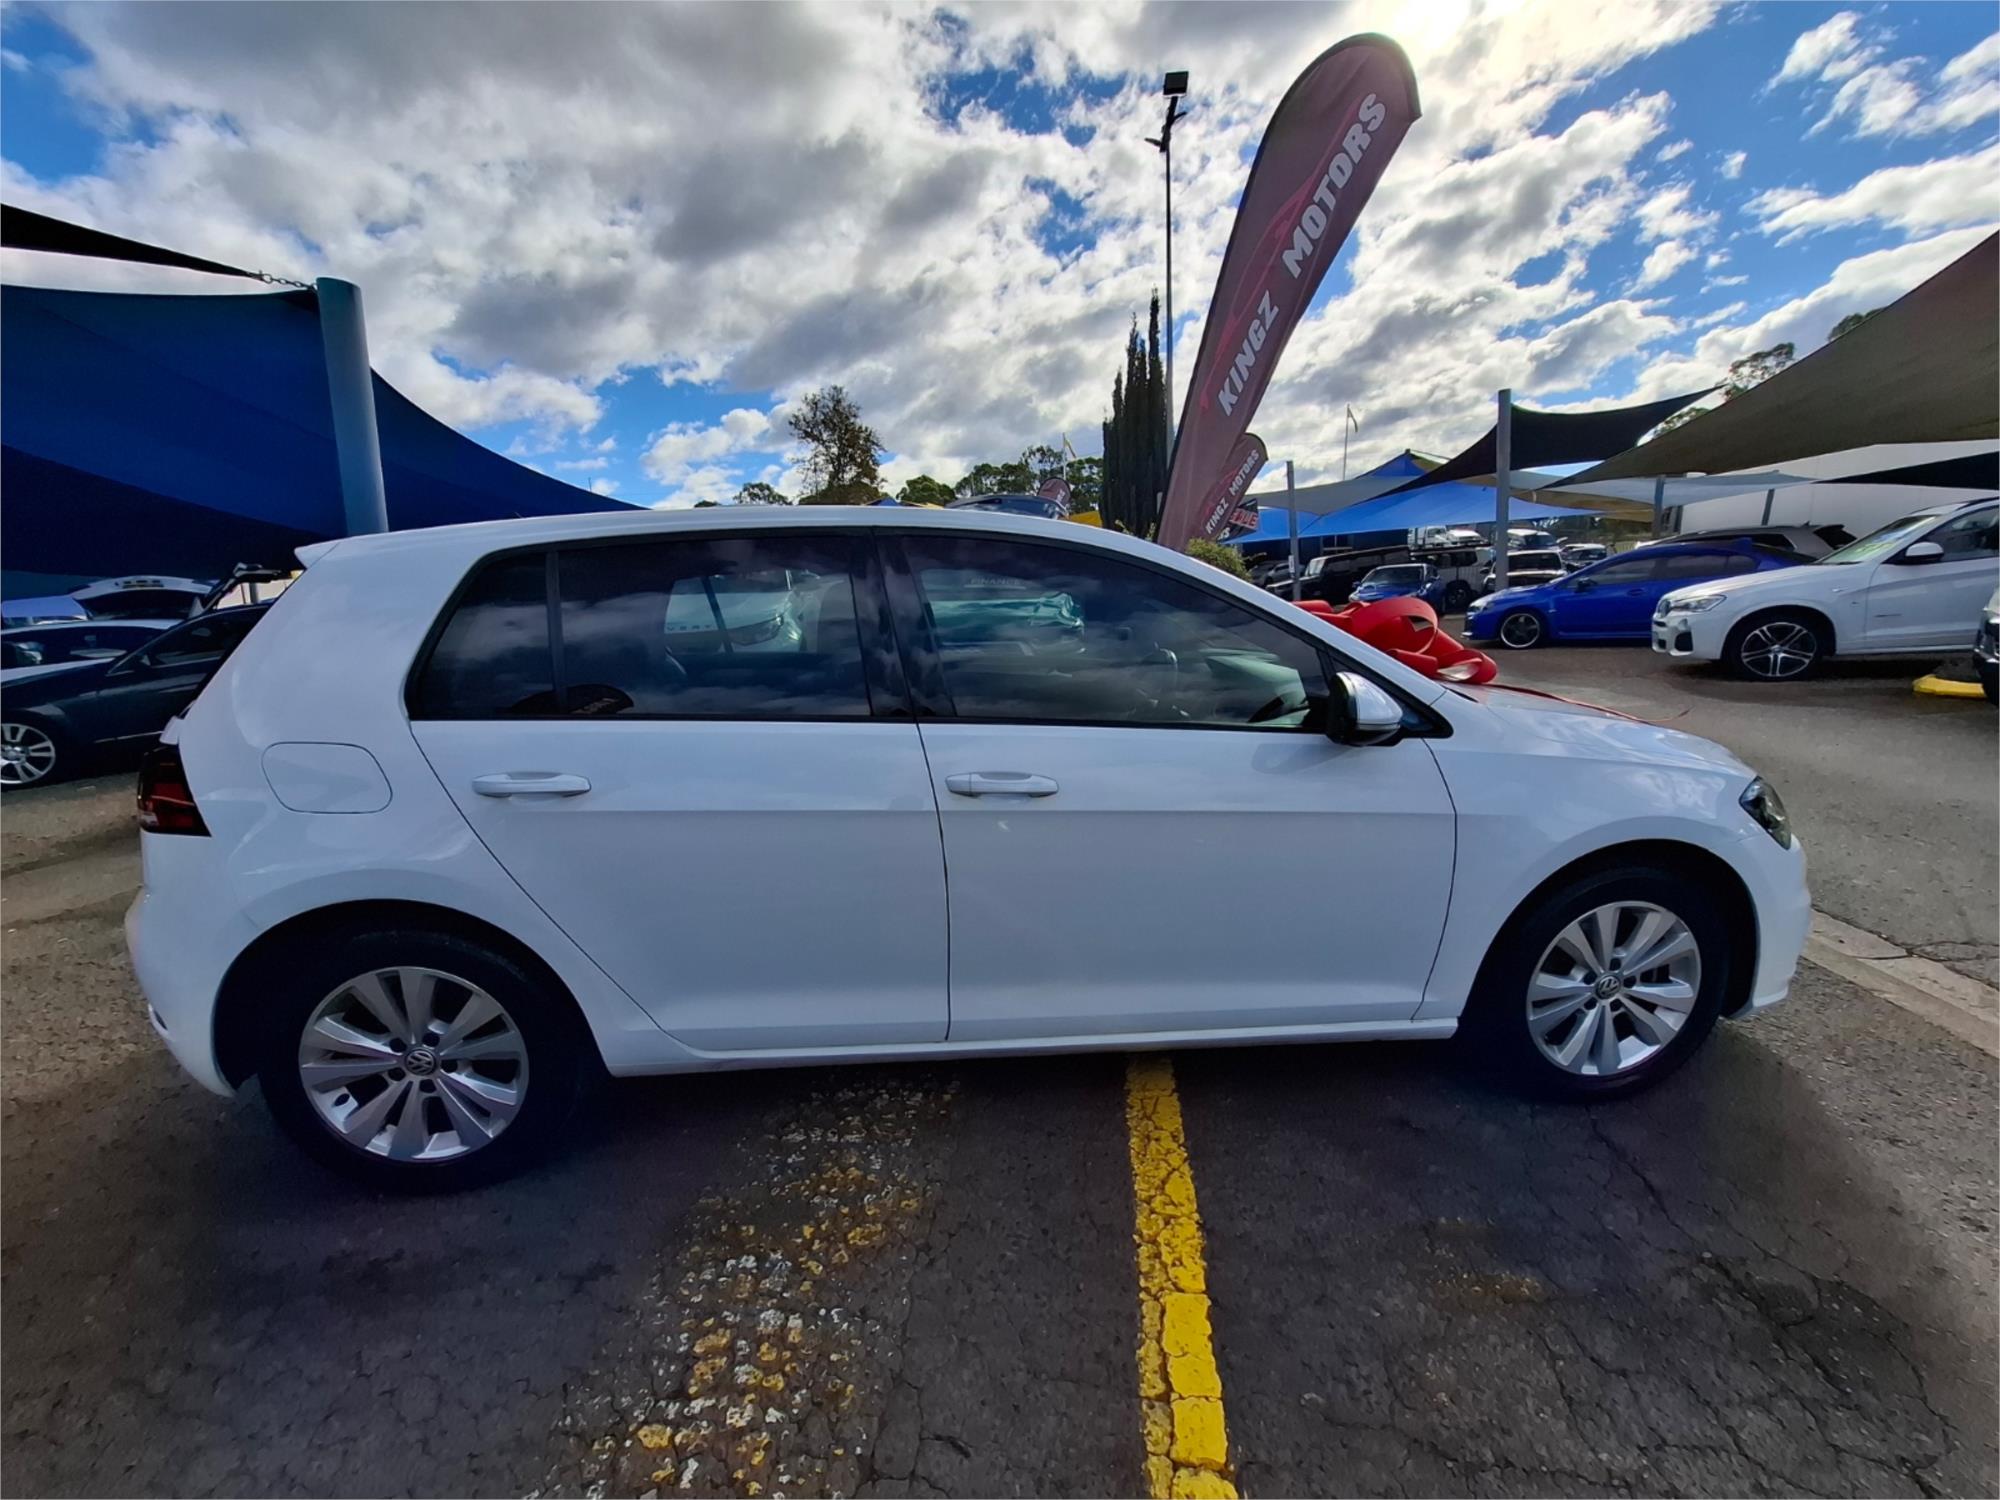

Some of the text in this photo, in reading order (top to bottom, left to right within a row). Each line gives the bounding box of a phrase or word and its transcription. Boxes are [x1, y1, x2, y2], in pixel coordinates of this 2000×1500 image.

[1218, 93, 1386, 416] KINGZ MOTORS
[1205, 498, 1229, 534] KINGZ
[1229, 449, 1259, 495] MOTORS
